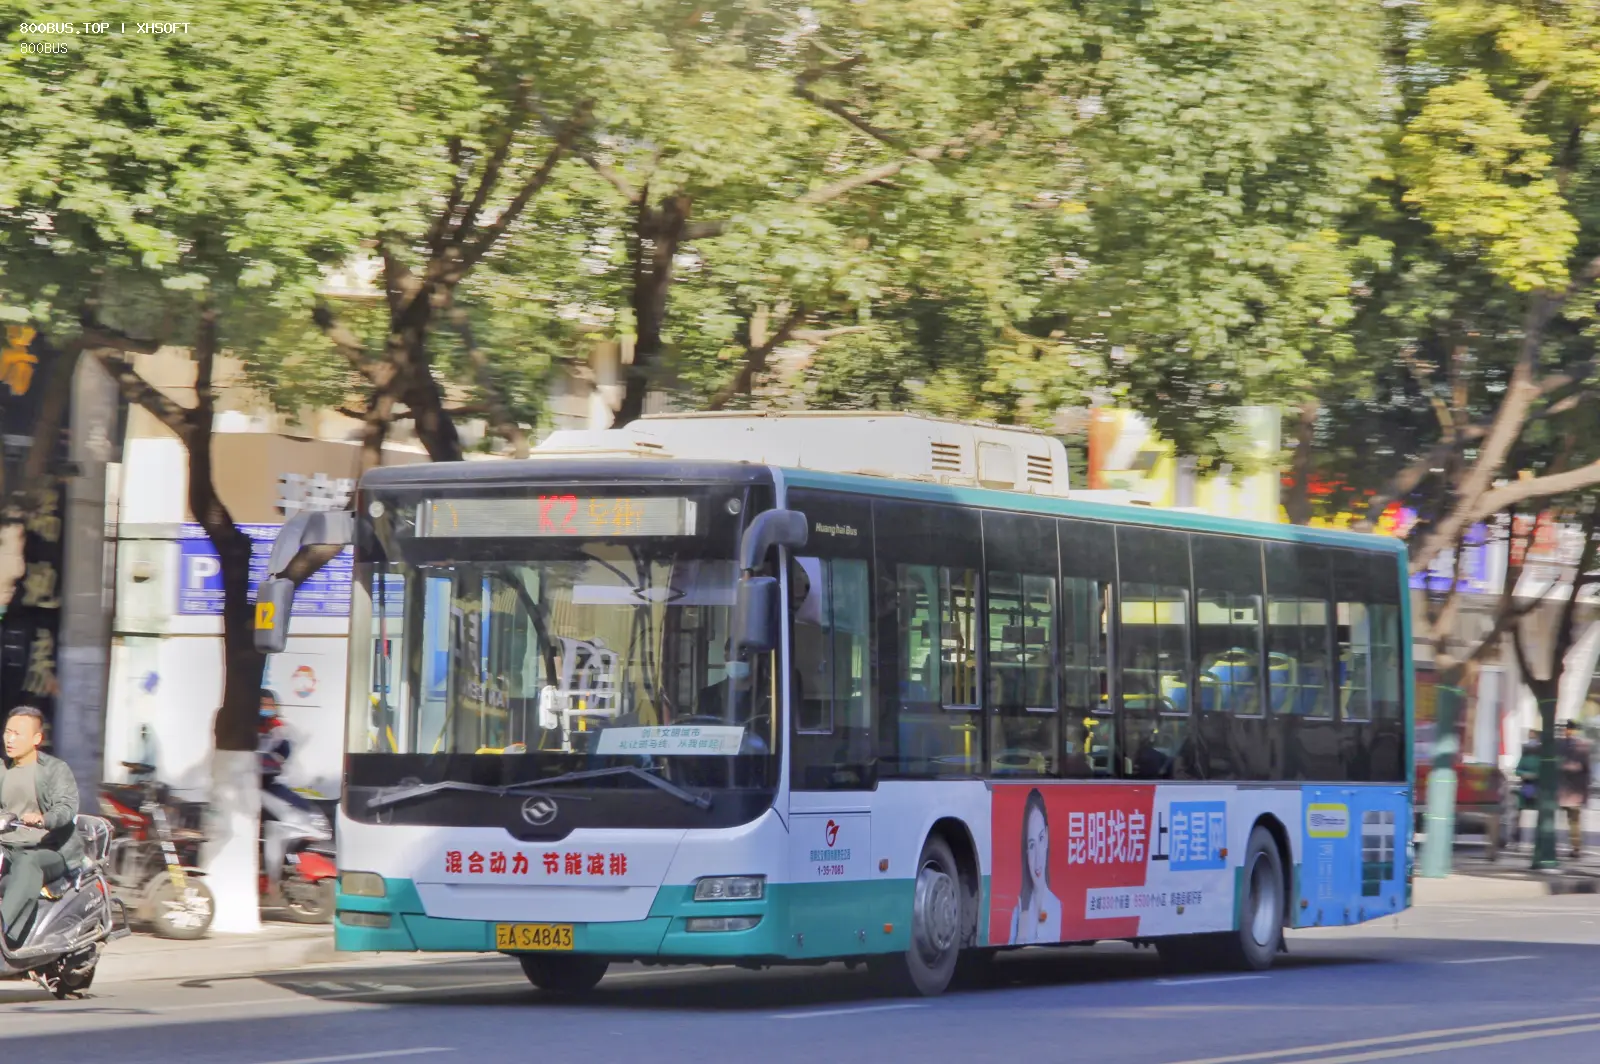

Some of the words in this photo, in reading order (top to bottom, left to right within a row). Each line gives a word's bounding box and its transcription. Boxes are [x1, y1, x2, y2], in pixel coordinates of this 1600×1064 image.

[538, 495, 578, 533] K2
[846, 525, 857, 536] Bus
[188, 556, 221, 589] P
[641, 728, 701, 738] 创文明城市
[445, 851, 529, 874] 混合动力
[542, 852, 627, 875] 节能减排
